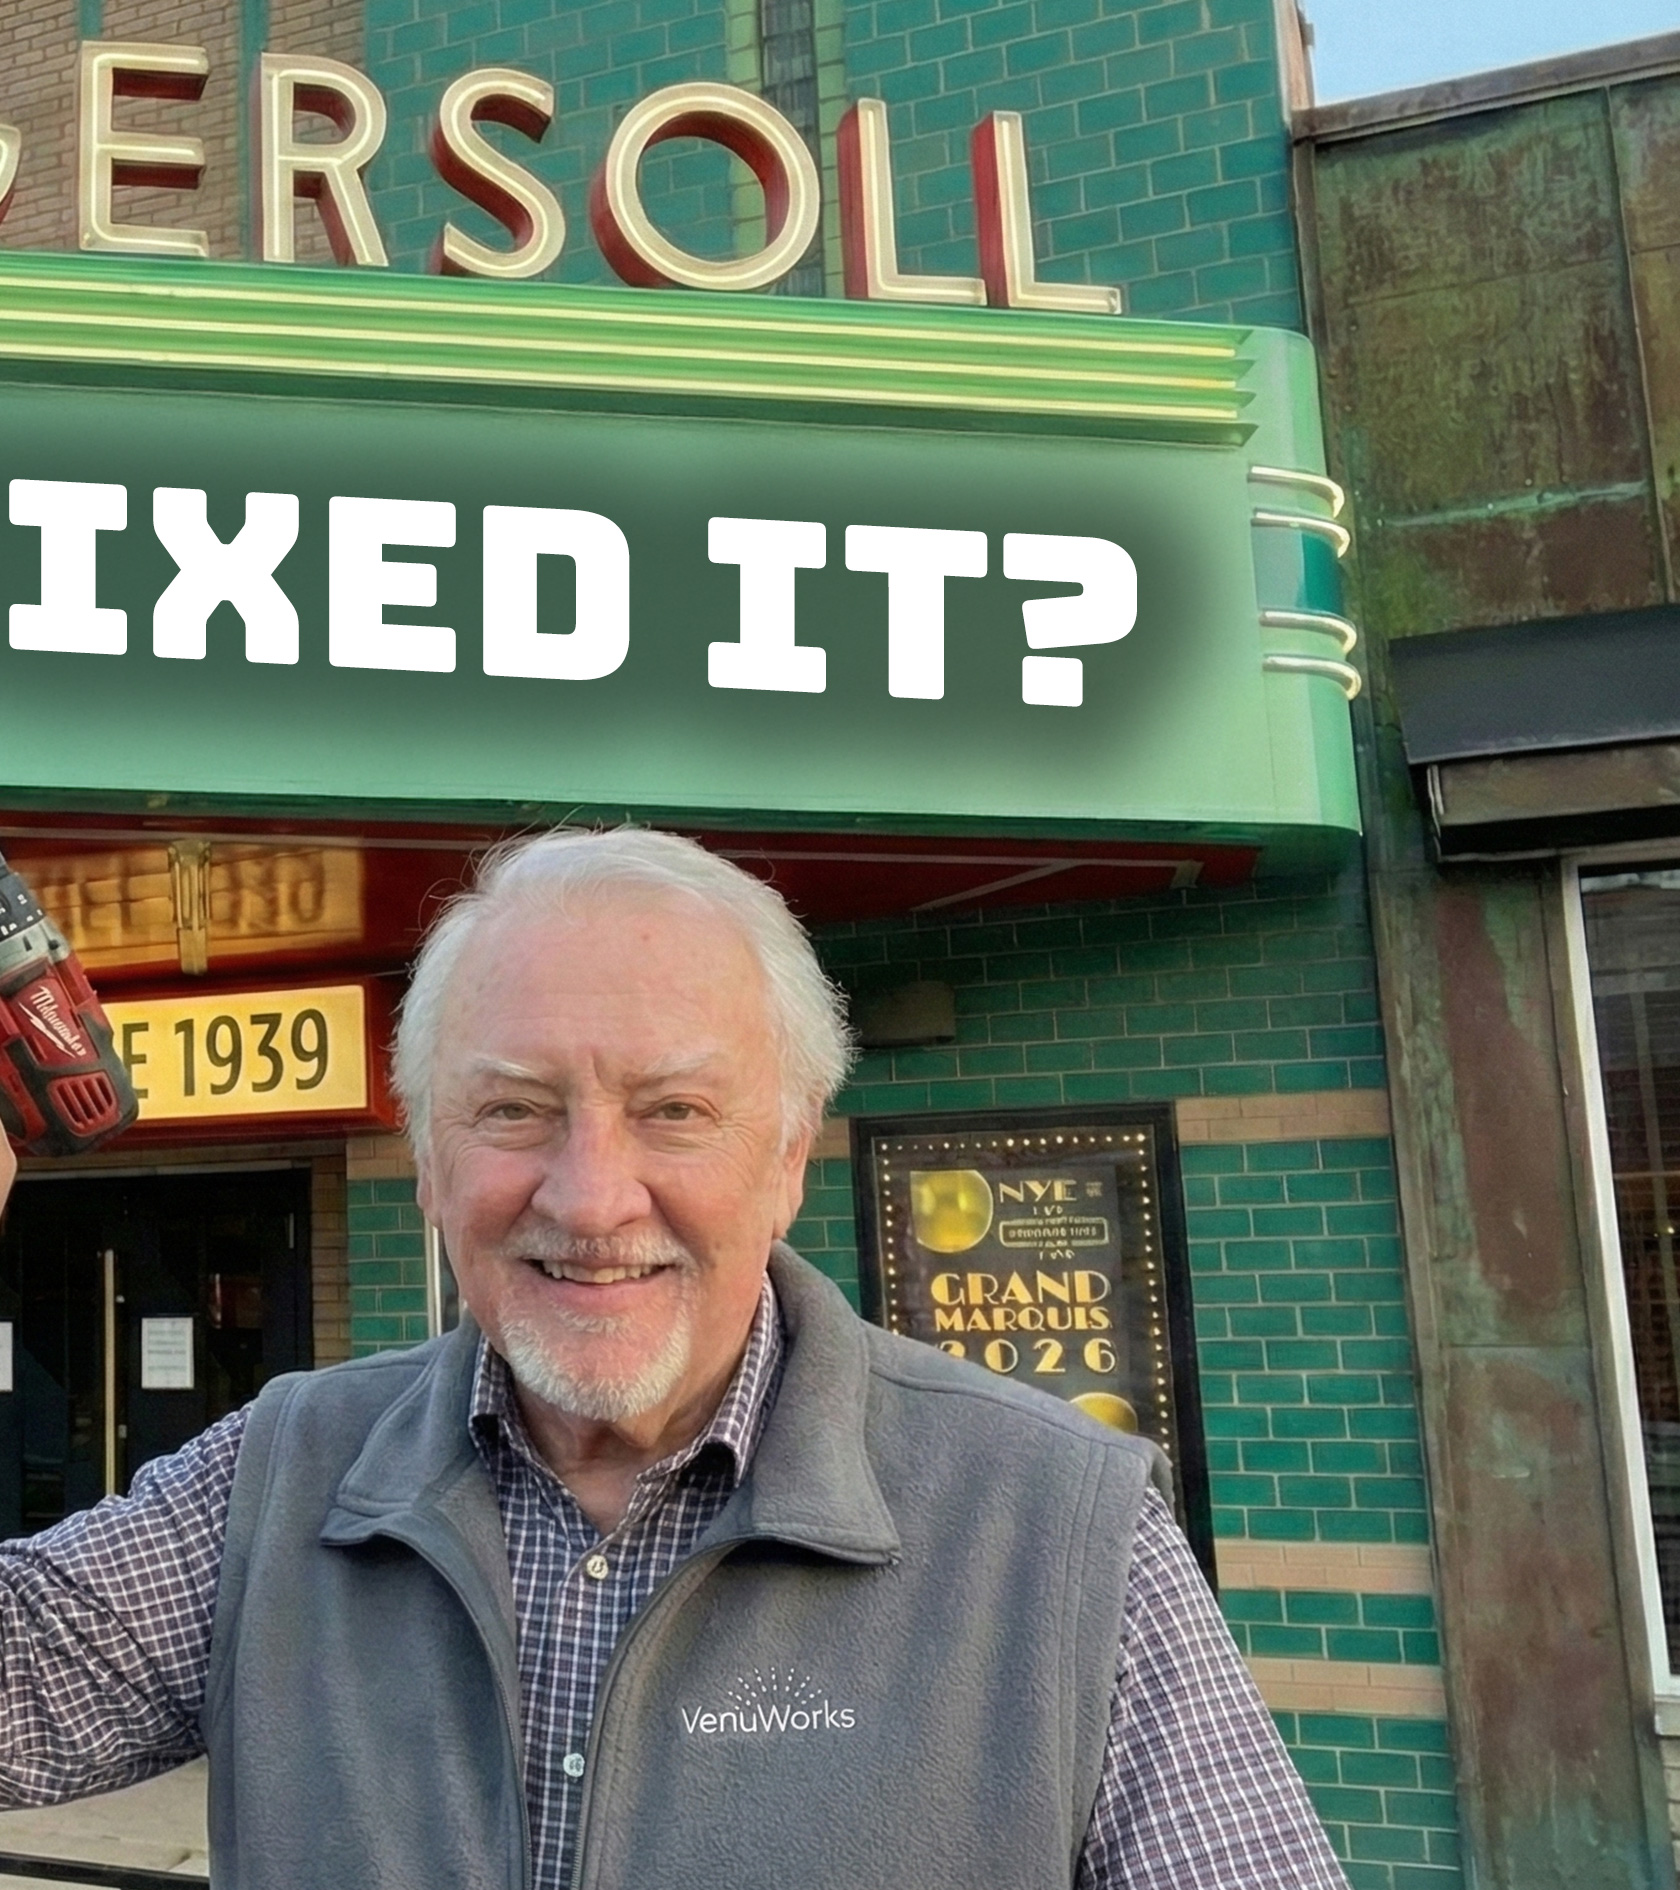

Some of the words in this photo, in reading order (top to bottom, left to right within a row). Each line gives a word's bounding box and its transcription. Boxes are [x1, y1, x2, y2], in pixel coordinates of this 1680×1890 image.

[173, 1008, 329, 1098] 1939
[998, 1178, 1078, 1204] NYE
[930, 1269, 1112, 1306] GRAND
[934, 1305, 1114, 1332] MARQUIS
[681, 1699, 857, 1735] VenuWorks
